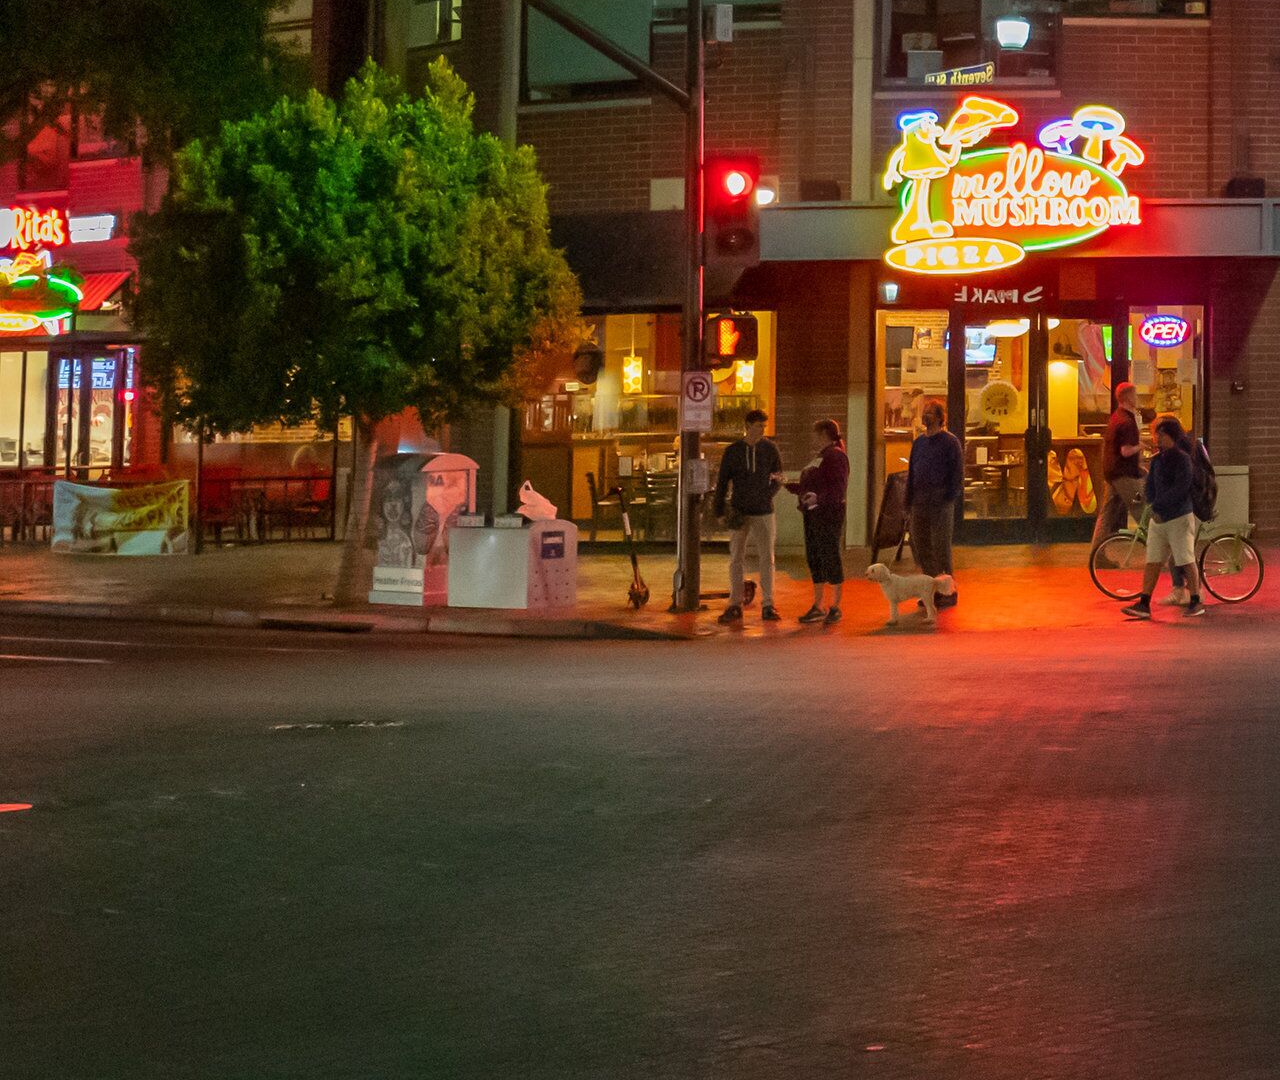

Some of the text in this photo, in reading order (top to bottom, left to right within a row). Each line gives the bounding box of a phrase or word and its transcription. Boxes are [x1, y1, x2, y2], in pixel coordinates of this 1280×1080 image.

[951, 142, 1101, 199] mellow
[951, 195, 1142, 227] MUSHROOM
[11, 207, 65, 250] Rita's
[904, 245, 1005, 266] PIZZA
[1141, 322, 1188, 341] OPEN
